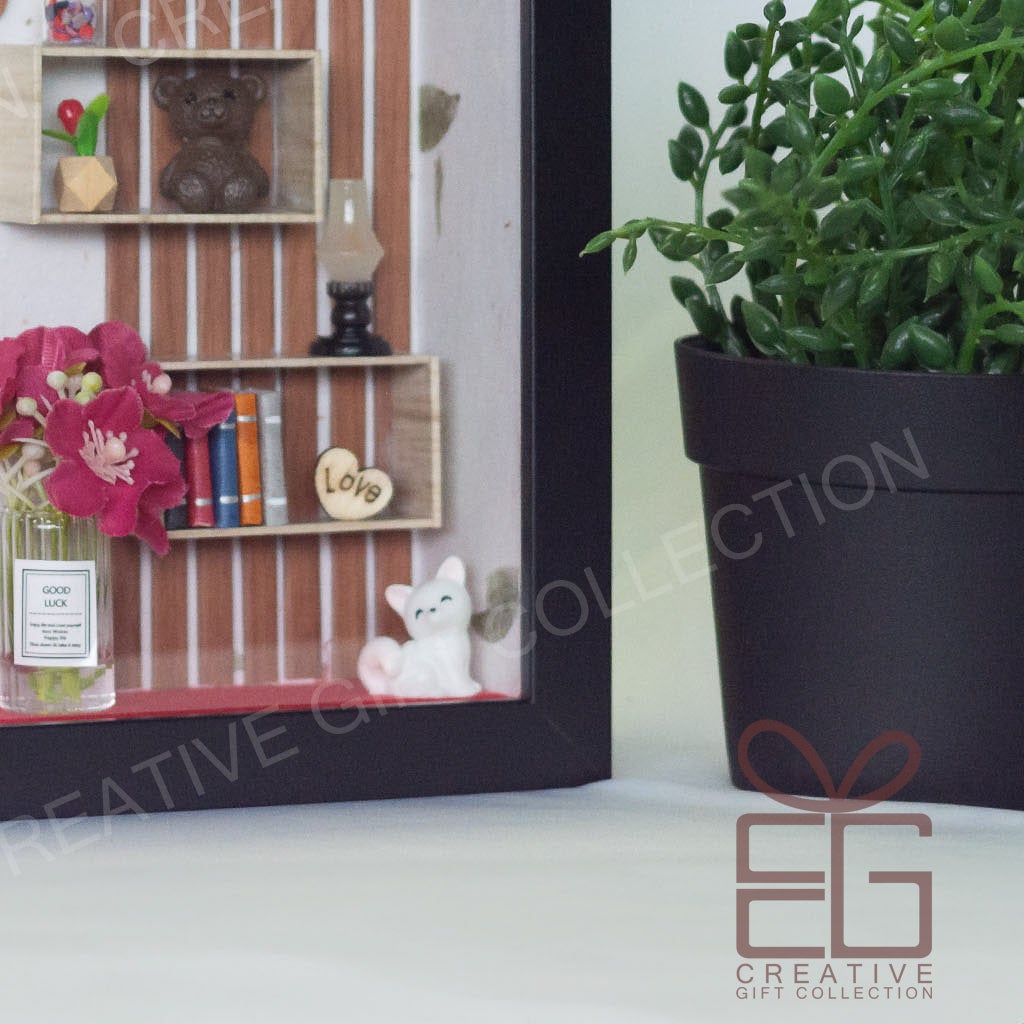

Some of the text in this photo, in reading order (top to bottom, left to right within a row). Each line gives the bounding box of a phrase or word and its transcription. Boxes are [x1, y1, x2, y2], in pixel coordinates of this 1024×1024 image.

[324, 467, 382, 503] Love
[42, 585, 71, 595] GOOD
[44, 598, 68, 608] LUCK
